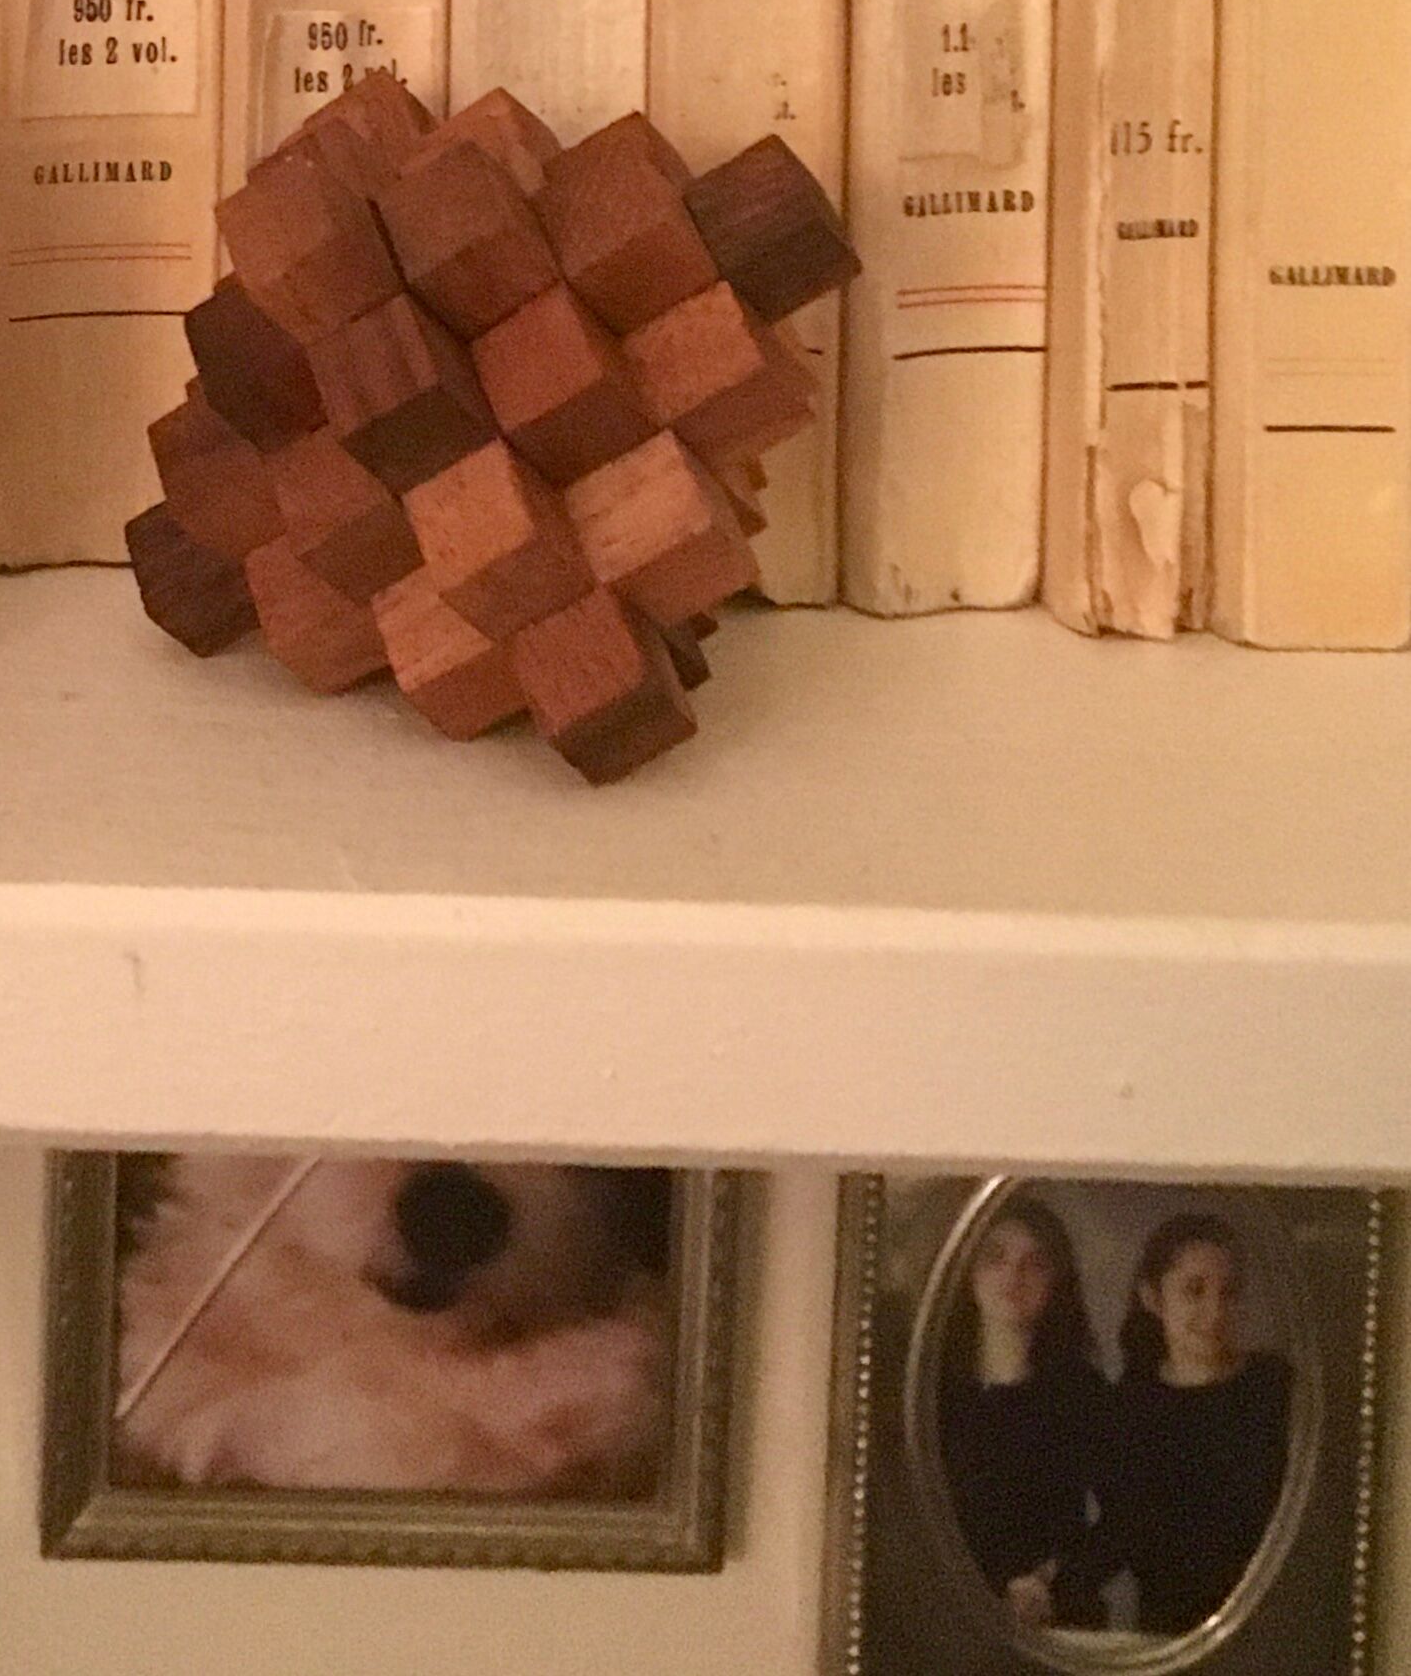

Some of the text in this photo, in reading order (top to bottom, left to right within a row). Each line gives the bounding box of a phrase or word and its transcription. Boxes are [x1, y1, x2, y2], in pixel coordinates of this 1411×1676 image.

[308, 19, 384, 51] 950 fr.
[58, 36, 179, 66] les 2 vol.
[294, 66, 329, 94] les
[341, 62, 354, 93] 2
[1166, 119, 1205, 154] fr.
[33, 160, 173, 185] GALLIMARD
[902, 189, 1035, 219] GALLIMARD
[1269, 265, 1397, 287] GALLIMARD
